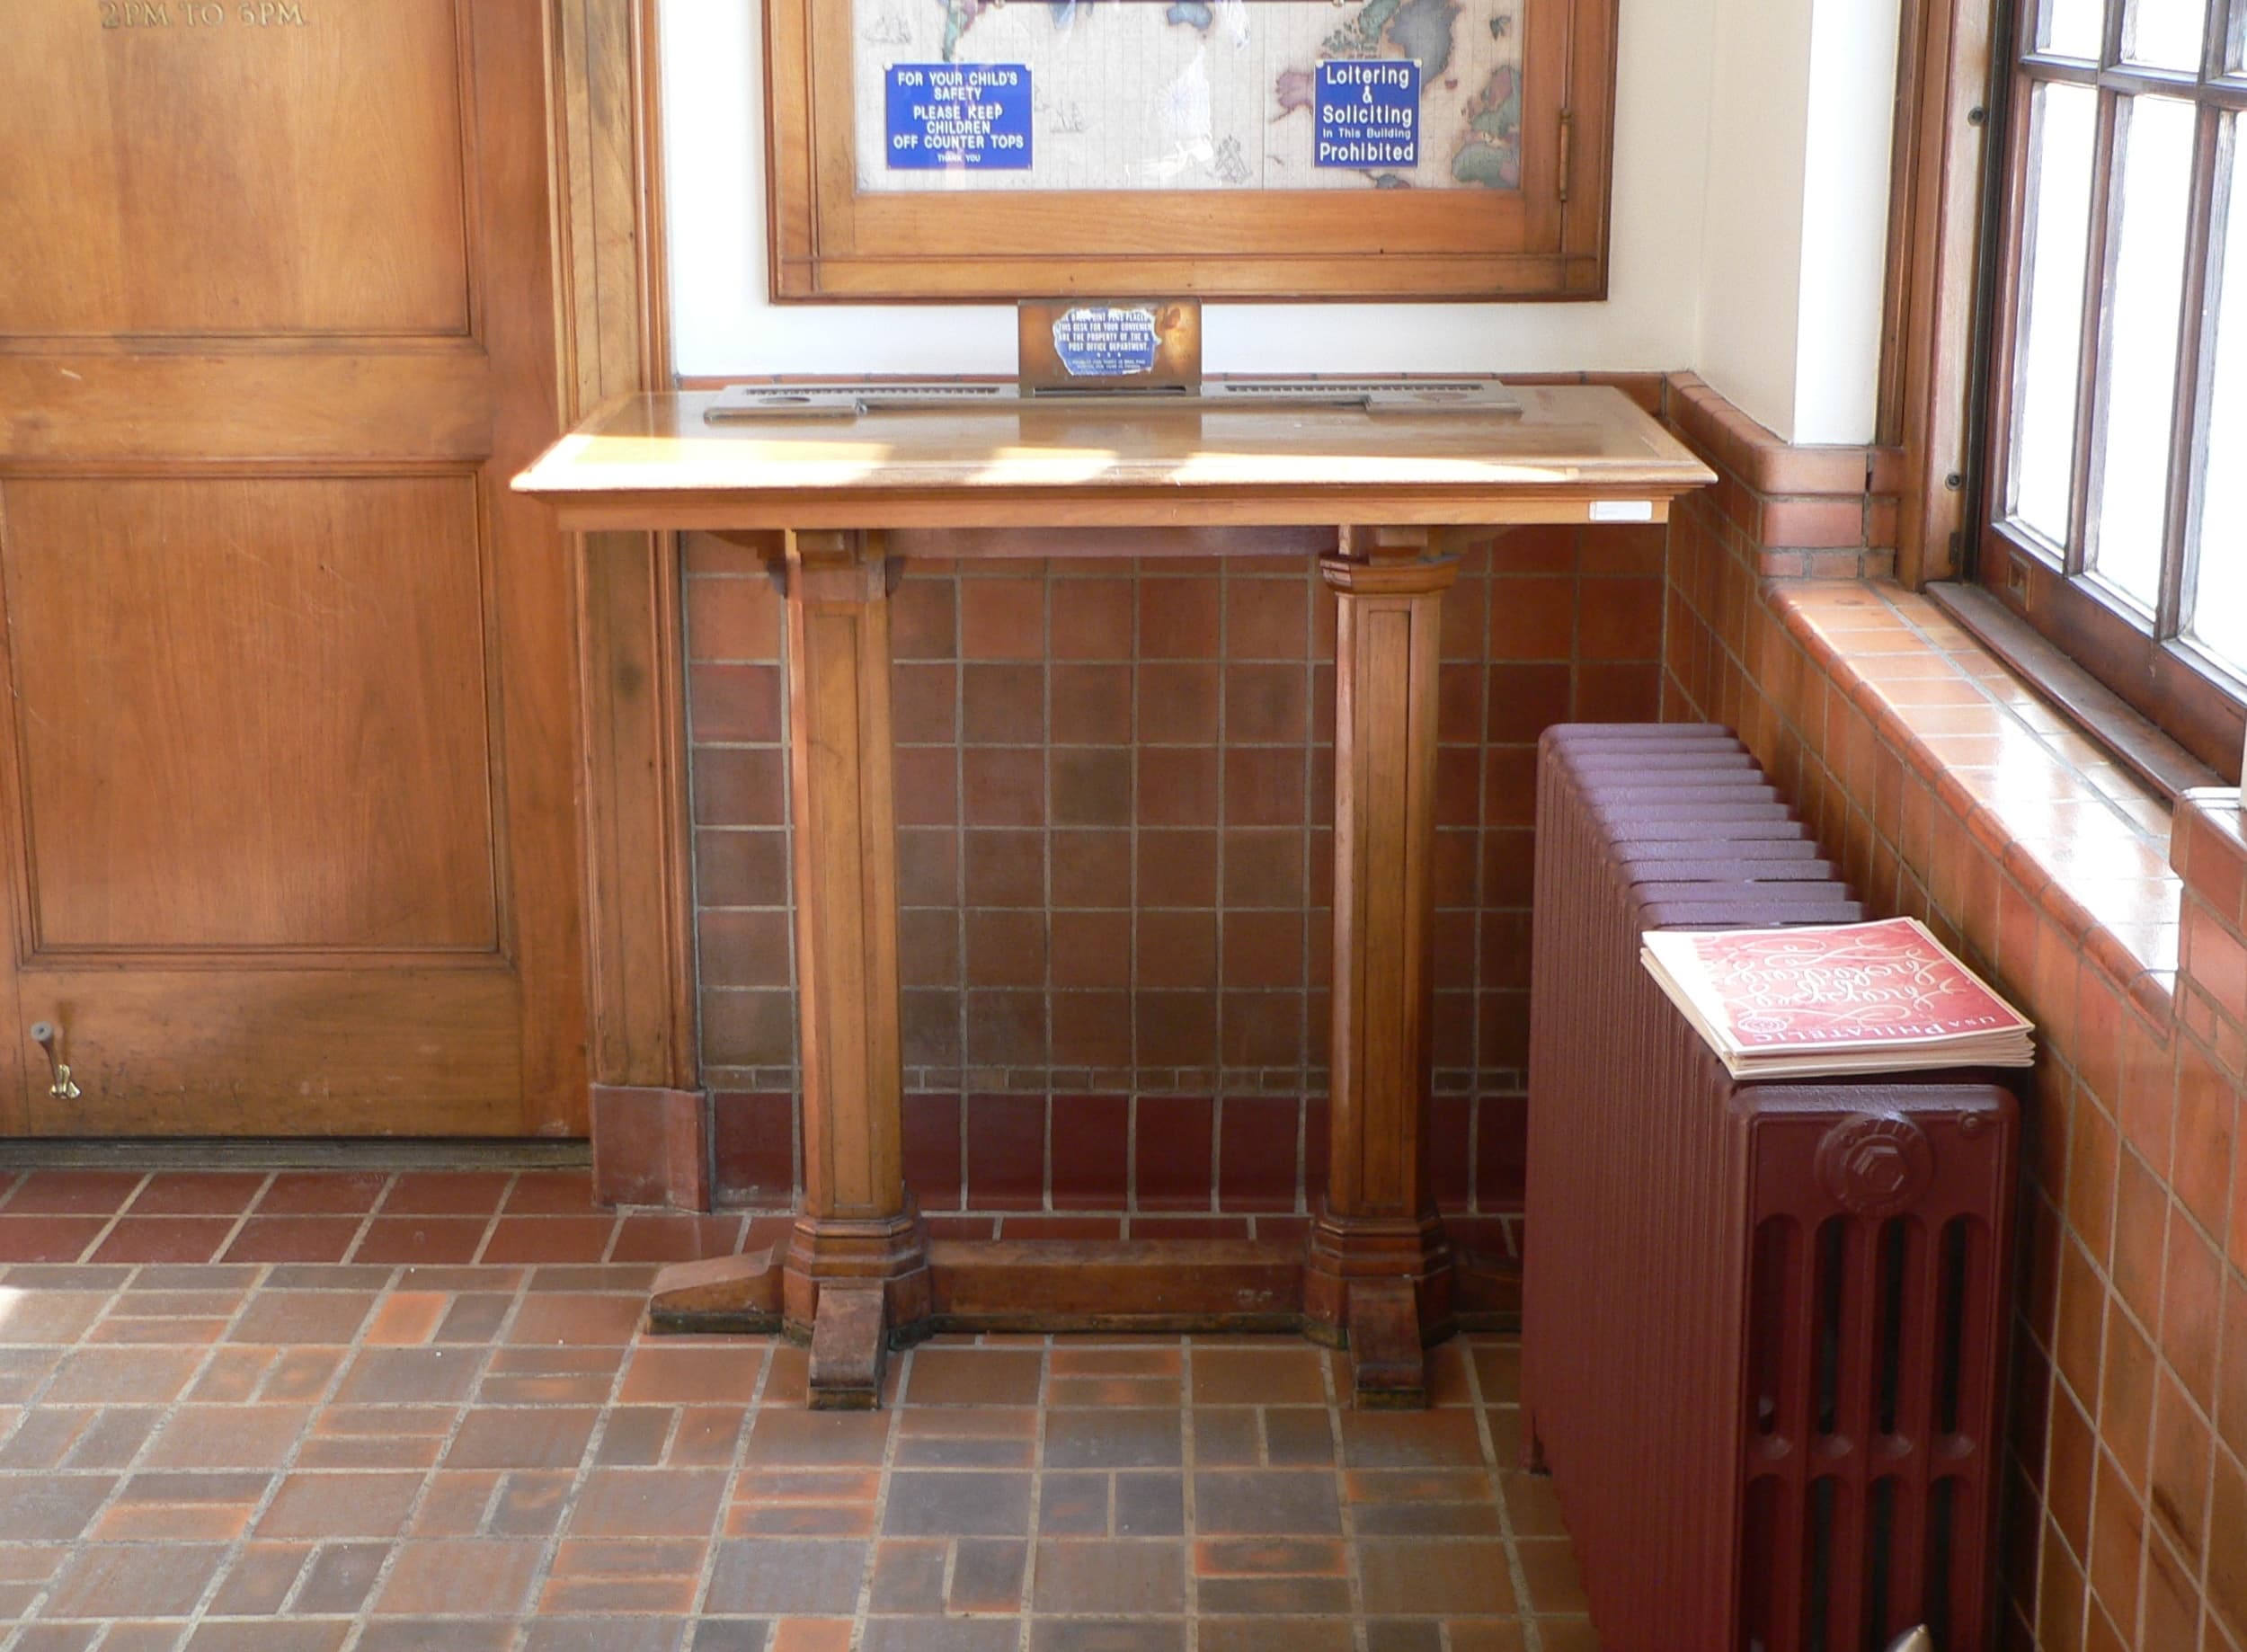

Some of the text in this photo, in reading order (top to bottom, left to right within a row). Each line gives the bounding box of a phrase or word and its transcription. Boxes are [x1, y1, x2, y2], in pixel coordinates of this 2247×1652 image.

[181, 3, 224, 26] TO
[898, 71, 1017, 86] FOR YOUR CHILD'S
[1327, 65, 1409, 89] Loitering
[934, 86, 982, 101] SAFETY
[1363, 85, 1372, 103] &
[913, 104, 1003, 120] PLEASE KEEP
[1323, 104, 1412, 128] Soliciting
[927, 120, 990, 134] CHILDREN
[1338, 128, 1361, 138] This
[1366, 128, 1411, 140] Building
[893, 135, 1024, 149] OFF COUNTER TOPS
[937, 153, 981, 163] THANK YOU
[1319, 142, 1414, 162] Prohibited
[1090, 323, 1101, 331] FOR
[1103, 323, 1118, 331] YOUR
[1073, 333, 1084, 342] THE
[1087, 333, 1117, 342] PROPERTY
[1120, 333, 1128, 342] OF
[1131, 333, 1141, 342] THE
[1069, 342, 1084, 351] POST
[1086, 342, 1106, 351] OFFICE
[1753, 1016, 1996, 1043] USA PHILATELIC
